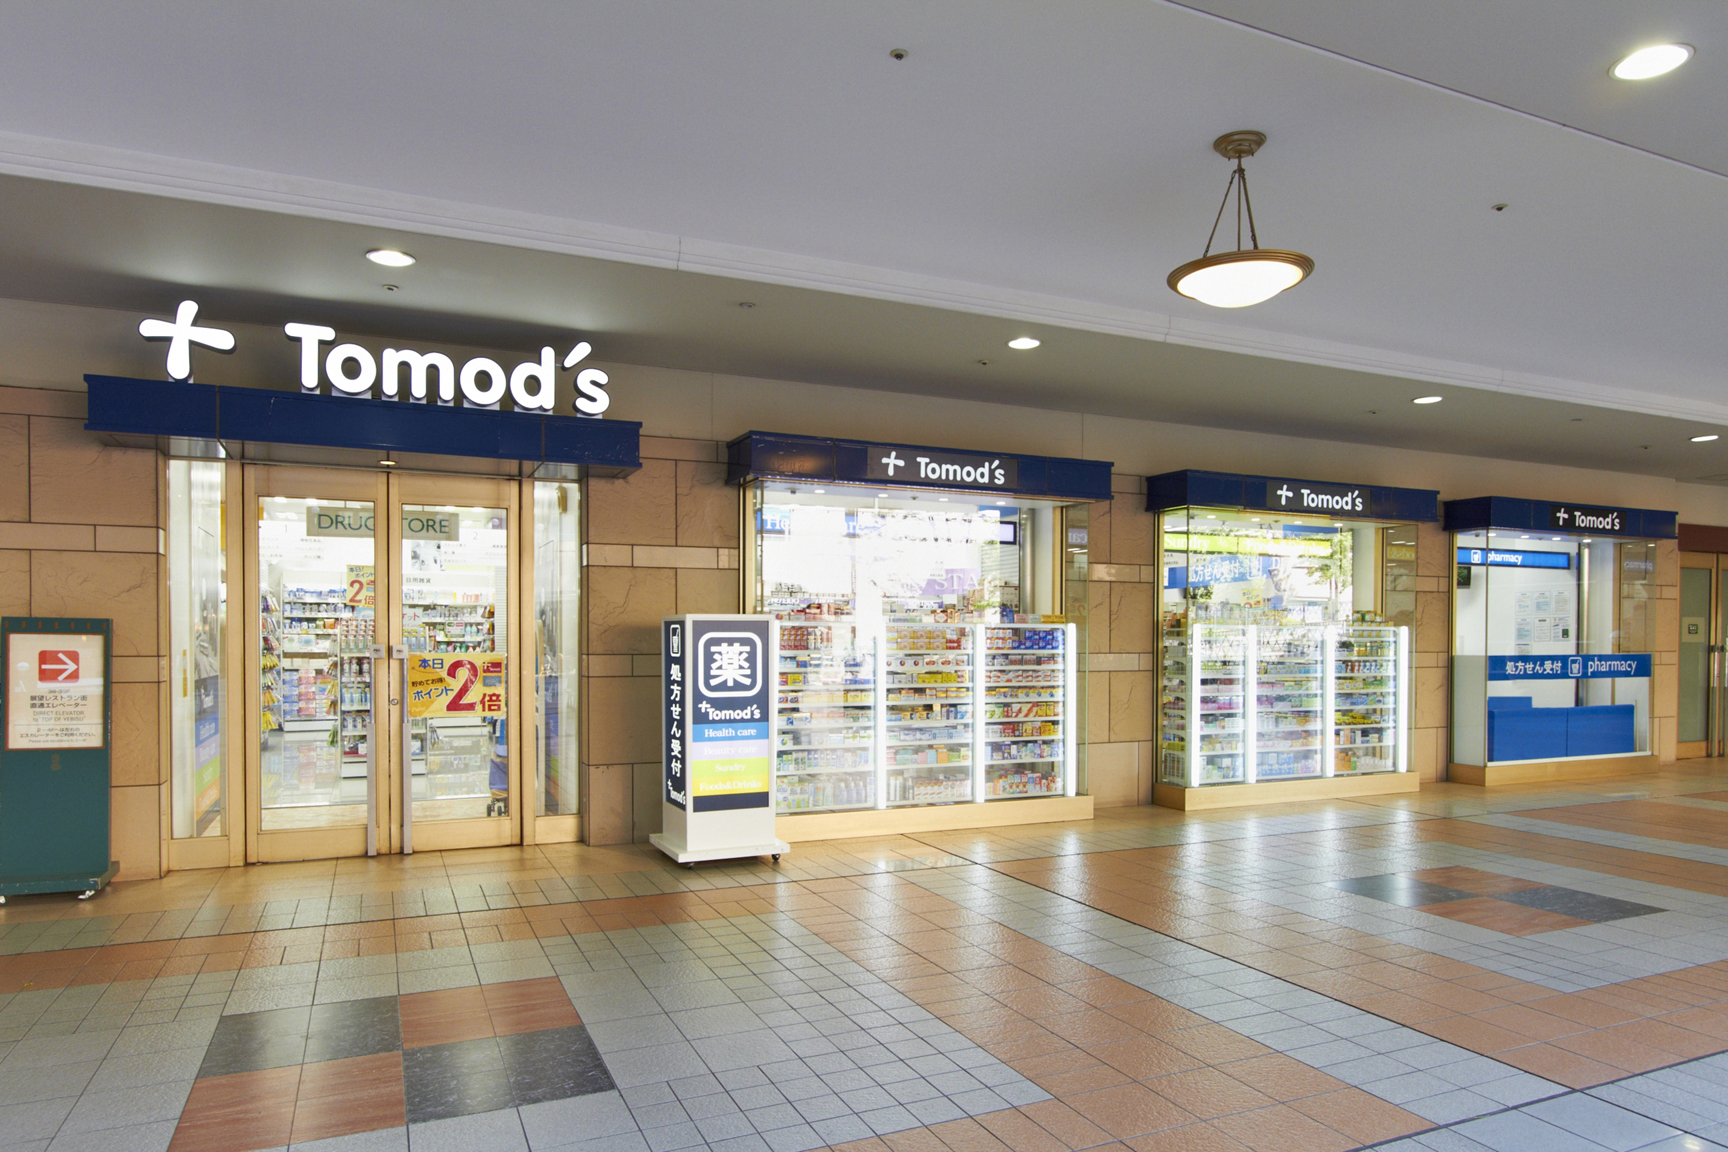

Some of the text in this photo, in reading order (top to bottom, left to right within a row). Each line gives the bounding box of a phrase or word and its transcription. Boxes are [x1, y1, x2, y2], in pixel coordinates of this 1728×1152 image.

[284, 321, 611, 416] Tomod's
[916, 457, 1005, 485] Tomod's
[1301, 489, 1363, 511] Tomod's
[1574, 511, 1620, 530] Tomod's
[1487, 553, 1522, 566] pharmacy
[419, 658, 443, 669] 本日
[709, 643, 752, 686] 薬
[1506, 660, 1562, 674] 処方せん受付
[1588, 657, 1637, 676] pharmacy
[413, 686, 454, 701] ポイント
[446, 659, 502, 712] 2 倍
[670, 663, 682, 777] 処方せん受付
[706, 704, 761, 720] Tomod's
[704, 728, 735, 737] Health
[704, 746, 757, 755] Beauty care
[715, 763, 746, 772] Sundry
